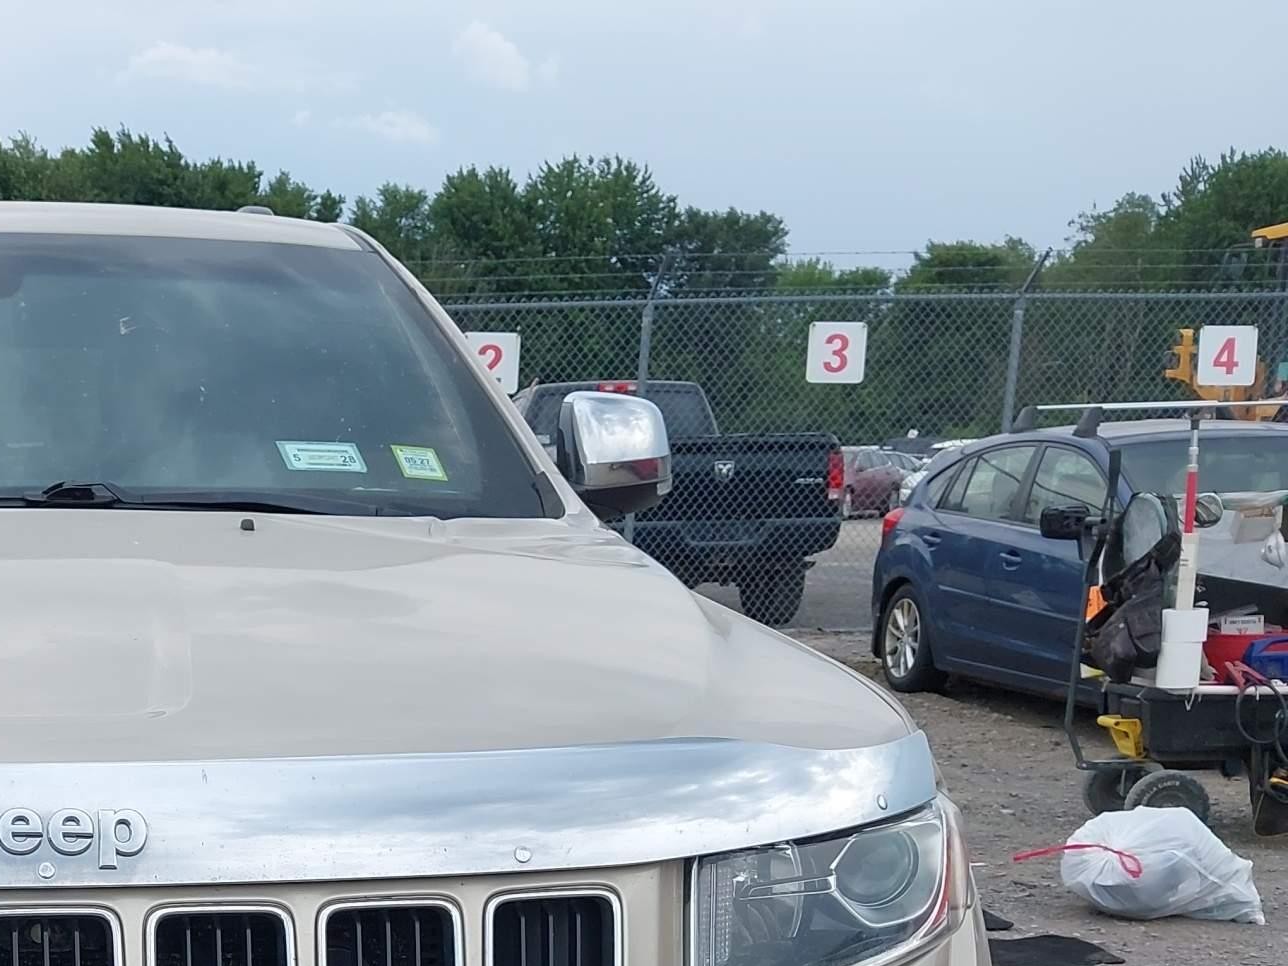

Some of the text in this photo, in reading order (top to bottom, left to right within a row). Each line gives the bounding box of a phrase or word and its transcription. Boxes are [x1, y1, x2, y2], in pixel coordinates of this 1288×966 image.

[823, 333, 849, 373] 3
[1212, 336, 1240, 375] 4
[292, 453, 302, 462] 5
[340, 455, 357, 464] 28
